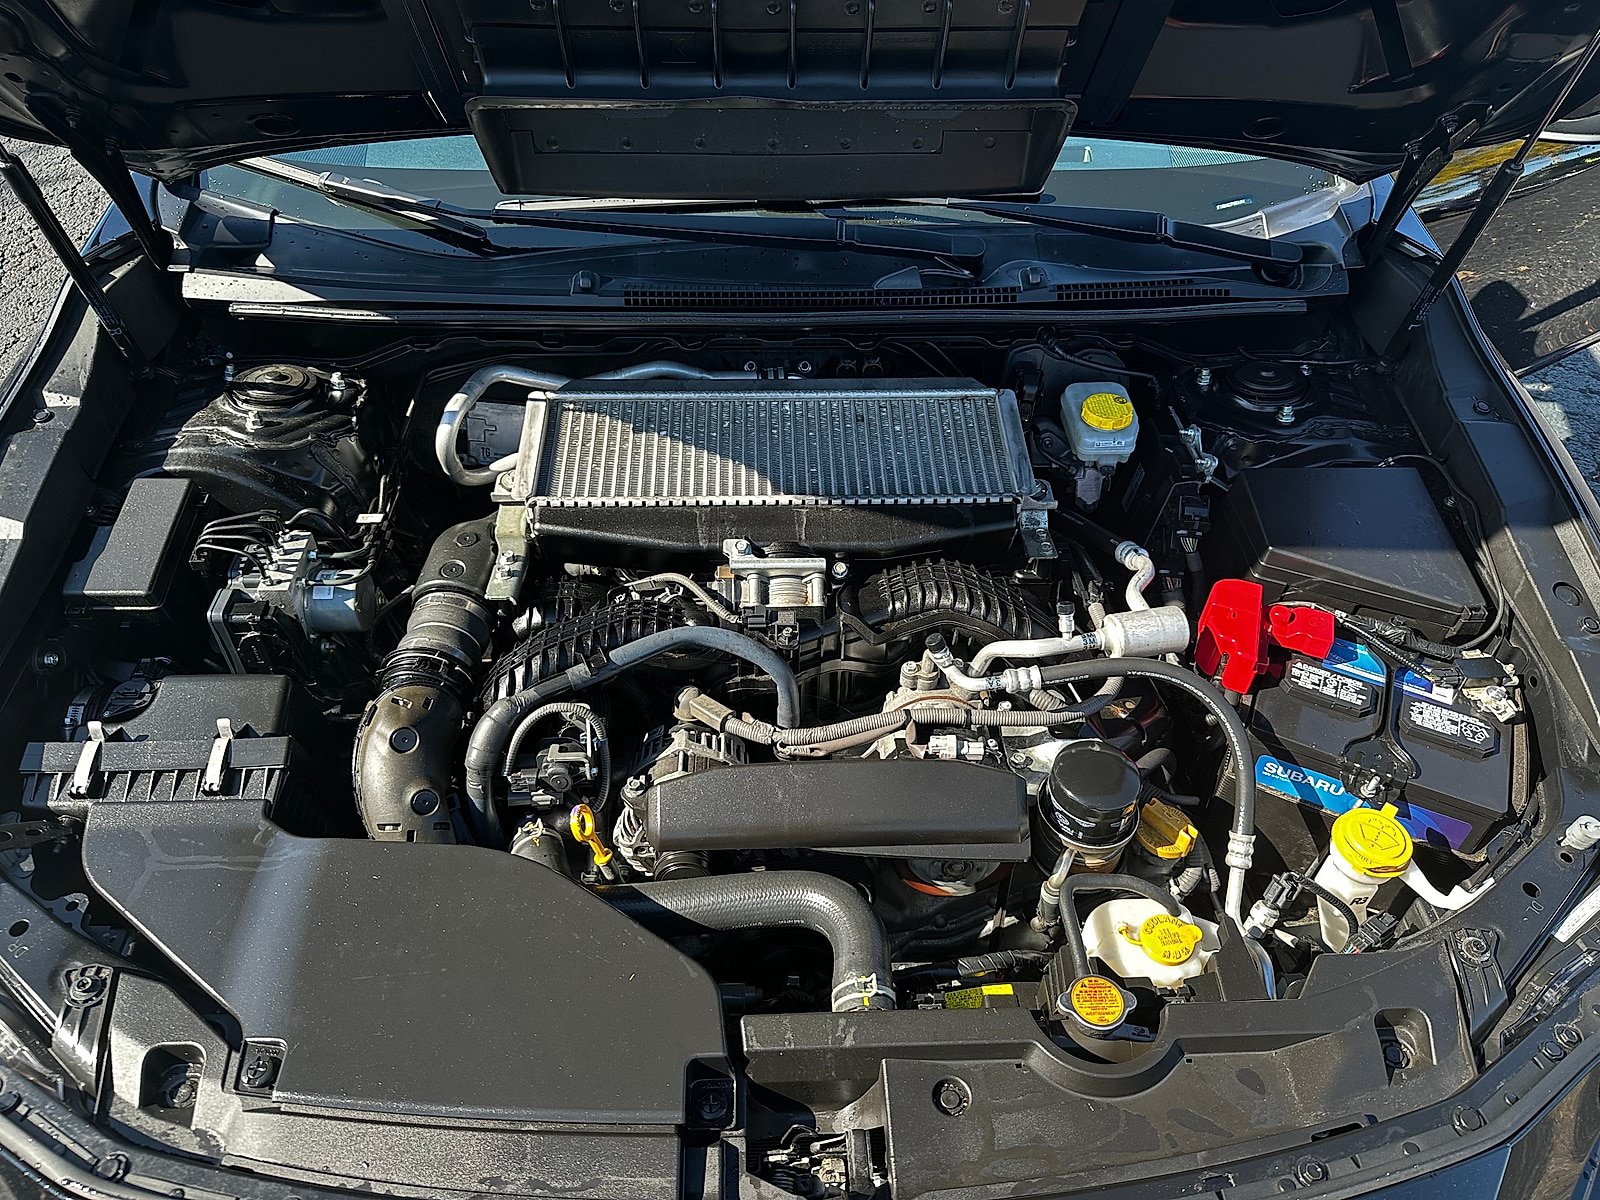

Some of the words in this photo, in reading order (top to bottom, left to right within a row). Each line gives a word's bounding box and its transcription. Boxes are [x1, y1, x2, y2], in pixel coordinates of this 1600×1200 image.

[481, 447, 491, 458] TG
[1263, 761, 1346, 796] SUBARU
[1349, 896, 1369, 906] R3
